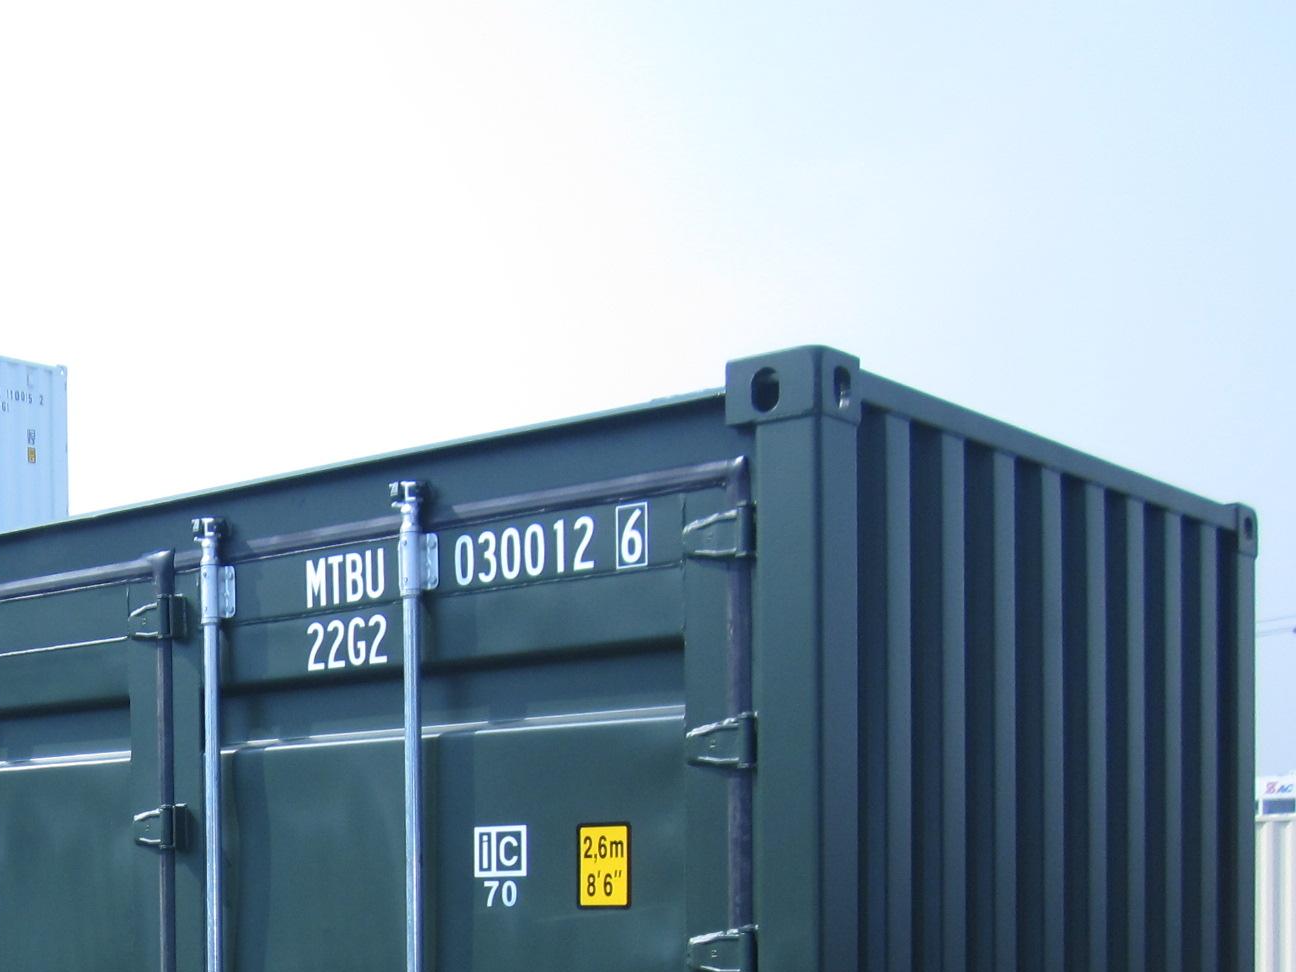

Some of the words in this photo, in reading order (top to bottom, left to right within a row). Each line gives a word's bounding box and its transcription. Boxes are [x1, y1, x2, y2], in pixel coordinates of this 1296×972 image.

[305, 547, 385, 609] MTBU
[454, 515, 596, 587] 030012
[620, 506, 644, 566] 6
[306, 613, 389, 672] 22G2
[483, 879, 518, 908] 70
